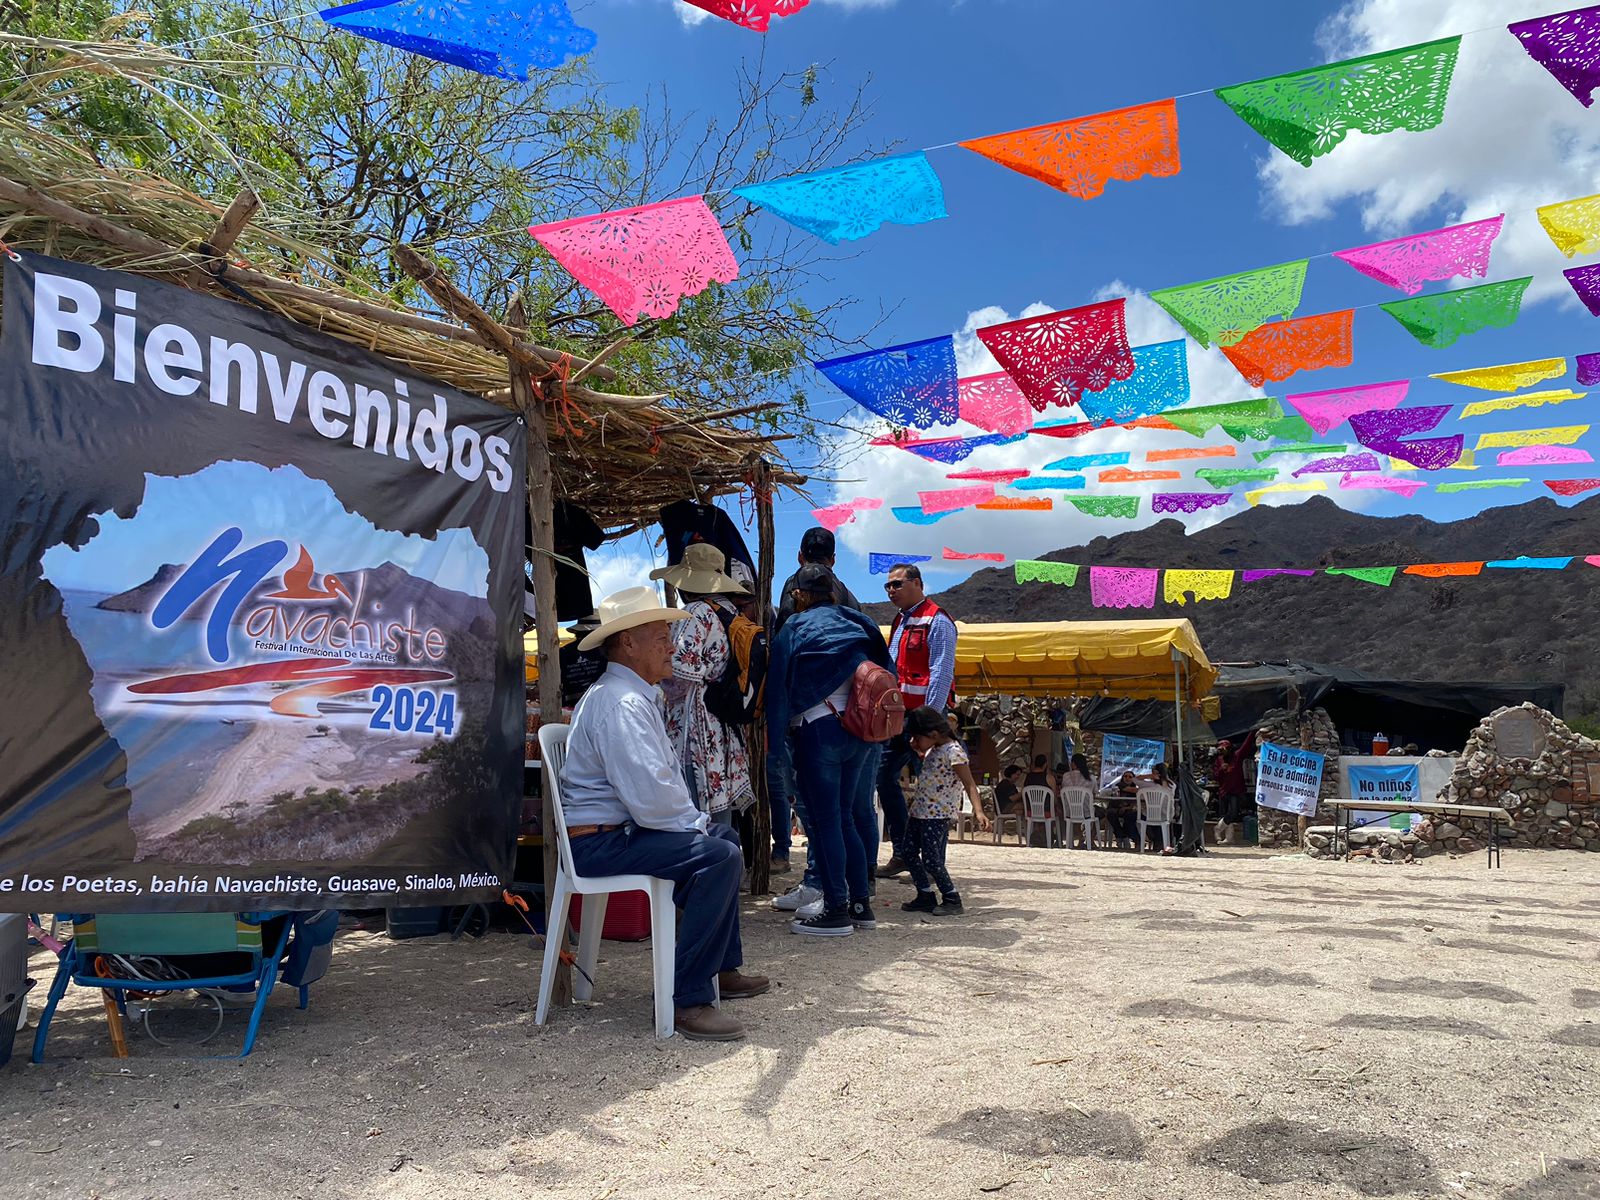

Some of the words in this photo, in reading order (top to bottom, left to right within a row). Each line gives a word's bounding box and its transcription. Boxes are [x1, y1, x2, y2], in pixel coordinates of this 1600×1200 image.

[32, 272, 513, 493] Bienvenidos
[254, 640, 287, 652] Festival
[289, 643, 342, 658] Internacional
[345, 650, 357, 658] De
[359, 651, 374, 659] Las
[375, 652, 397, 663] Artes
[369, 684, 455, 736] 2024
[1267, 749, 1278, 762] En
[1280, 752, 1288, 764] la
[1290, 755, 1317, 771] cocina
[1262, 764, 1272, 775] no
[1274, 767, 1284, 778] se
[1286, 769, 1318, 786] admiten
[1359, 779, 1374, 792] No
[1378, 779, 1412, 792] niños
[21, 874, 55, 892] los
[62, 875, 143, 895] Poetas,
[150, 875, 209, 893] bahía
[214, 876, 322, 894] Navachiste,
[327, 876, 401, 893] Guasave,
[405, 874, 456, 891] Sinaloa,
[459, 872, 501, 889] México.
